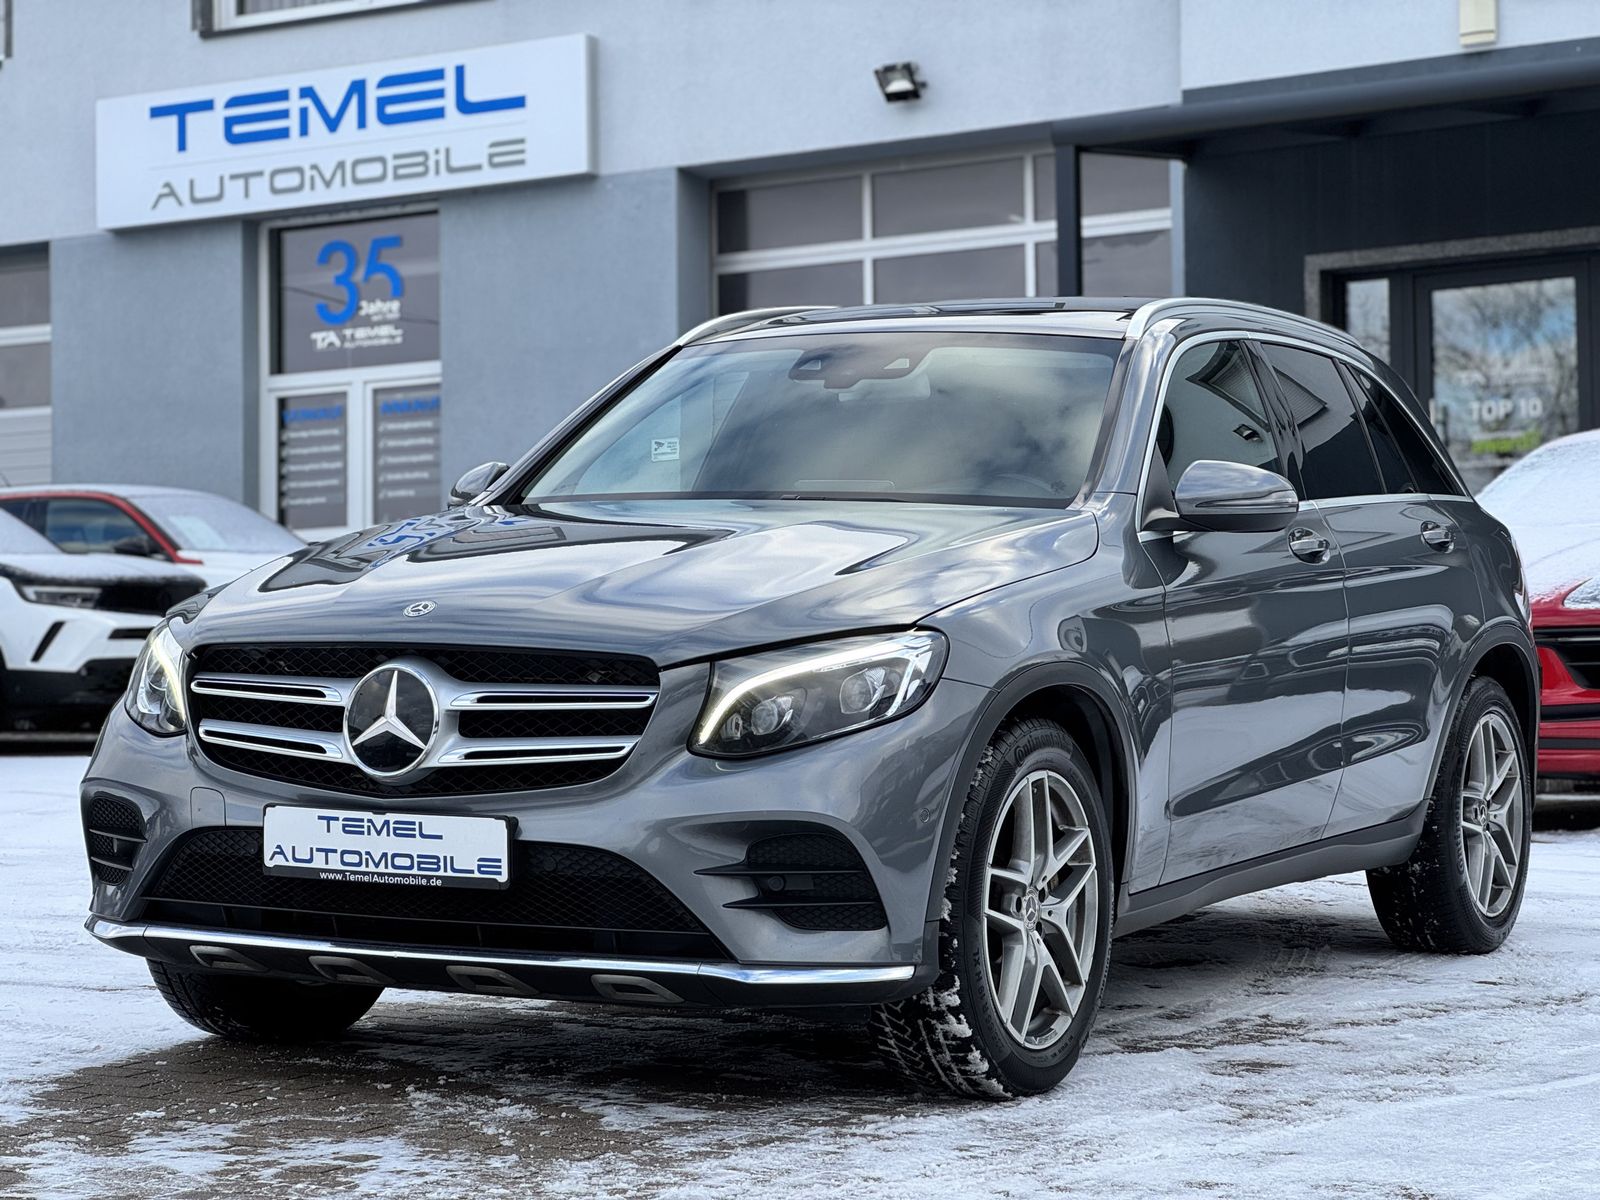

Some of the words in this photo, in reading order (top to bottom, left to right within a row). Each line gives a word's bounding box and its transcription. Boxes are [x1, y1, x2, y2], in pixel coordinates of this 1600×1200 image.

[149, 64, 526, 153] TEMEL
[315, 234, 404, 326] 35
[1471, 398, 1514, 422] TOP
[1519, 396, 1543, 419] 10
[317, 814, 444, 840] TEMEL
[269, 844, 503, 876] AUTOMOBILE
[319, 870, 443, 887] www.TemelAutomobile.de
